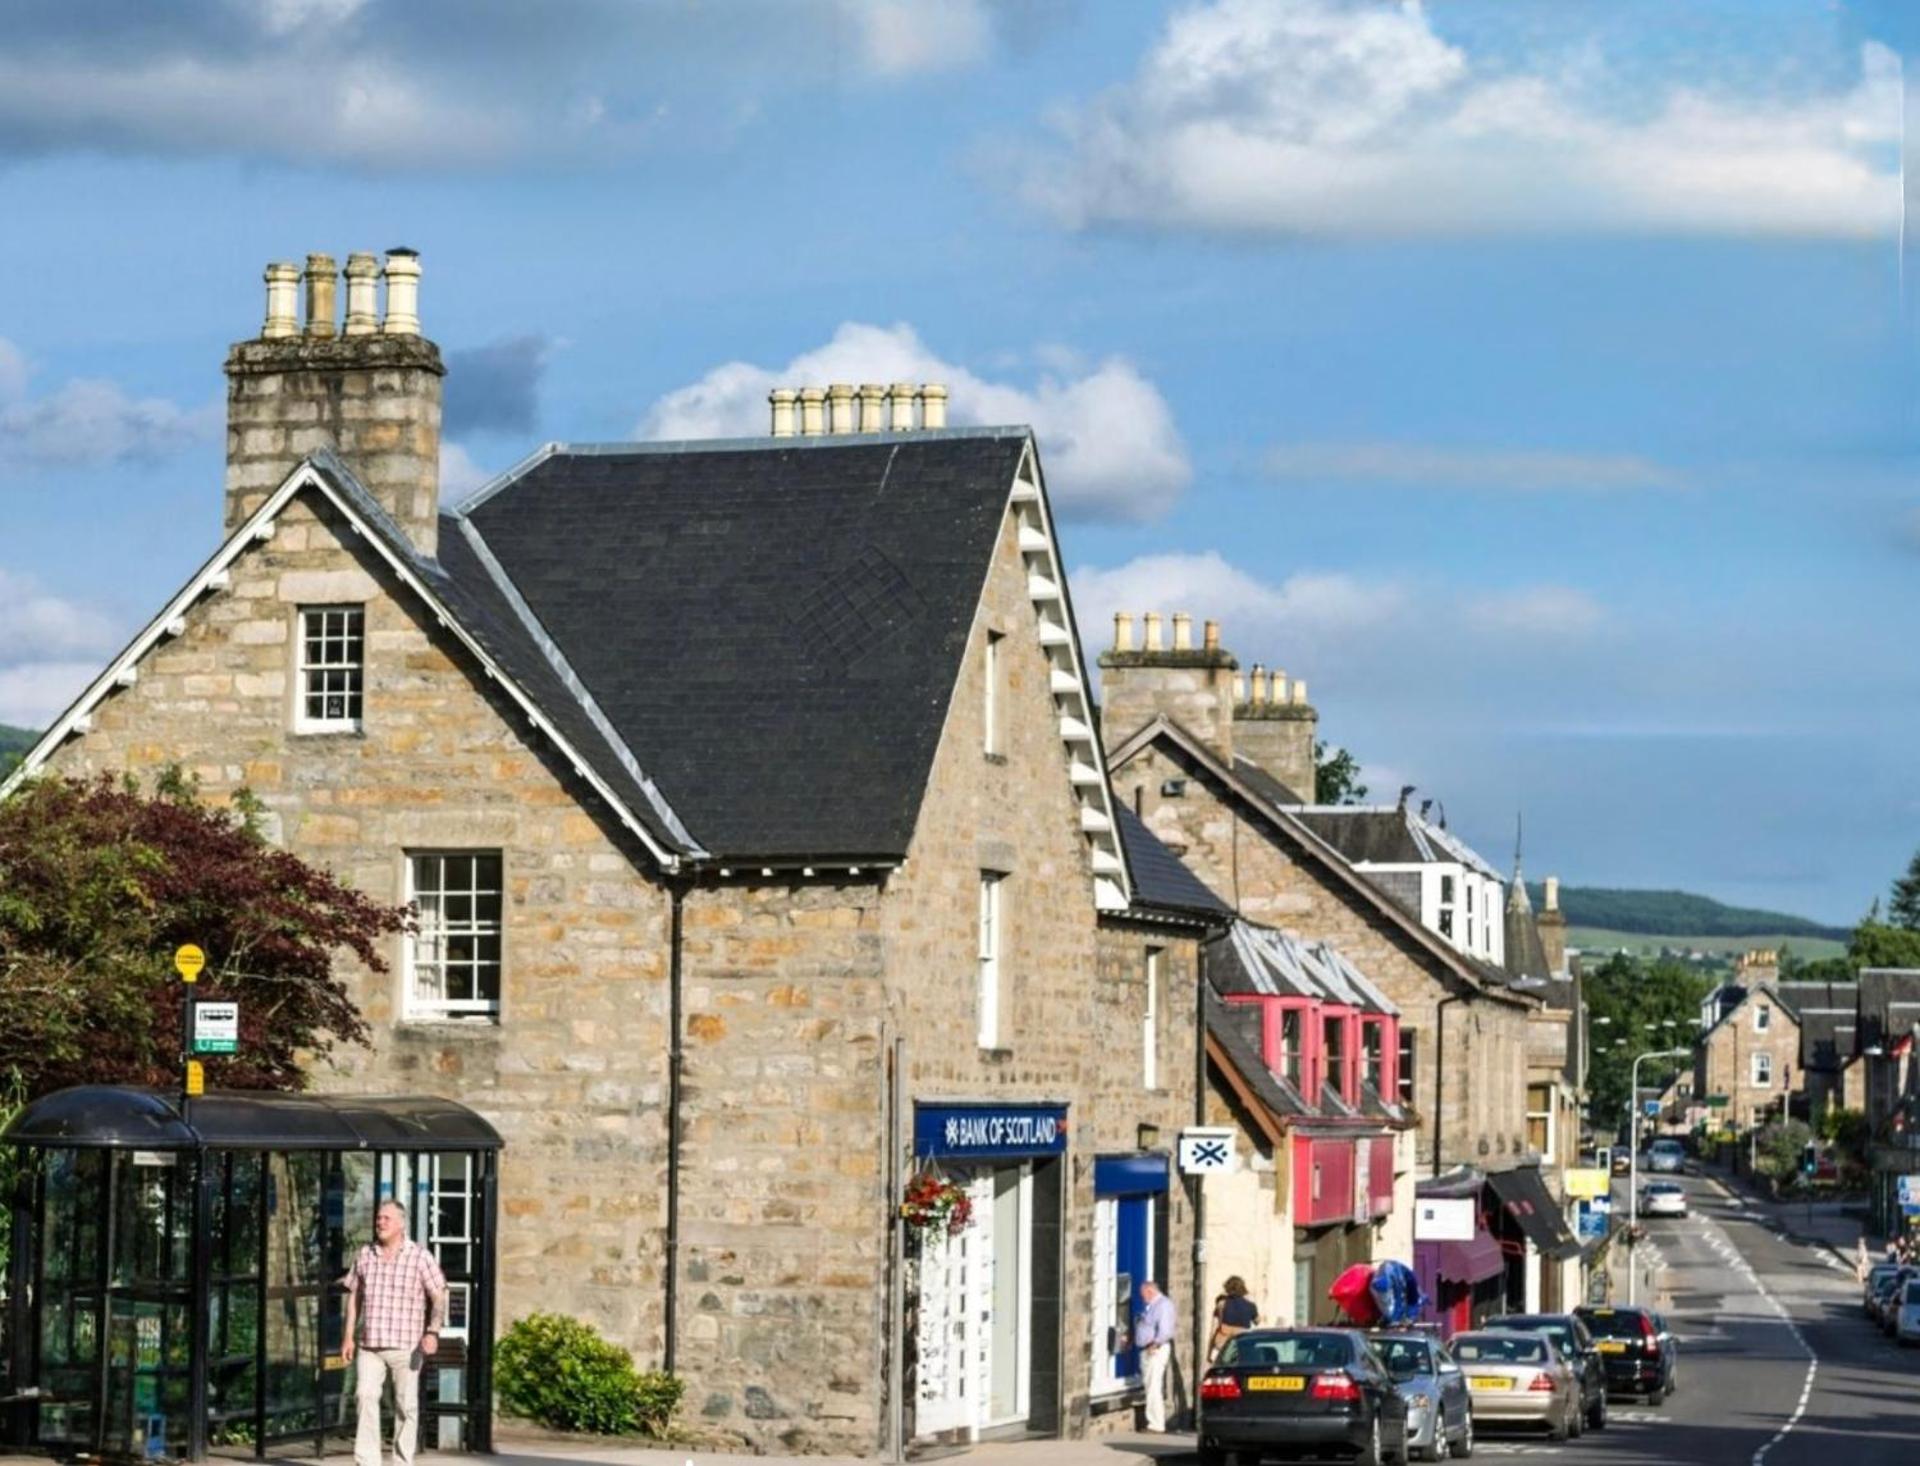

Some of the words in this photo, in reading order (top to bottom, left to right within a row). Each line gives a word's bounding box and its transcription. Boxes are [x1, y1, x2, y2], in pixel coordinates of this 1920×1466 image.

[960, 1117, 988, 1146] BANK
[989, 1117, 1004, 1144] OF
[1006, 1116, 1056, 1144] SCOTLAND
